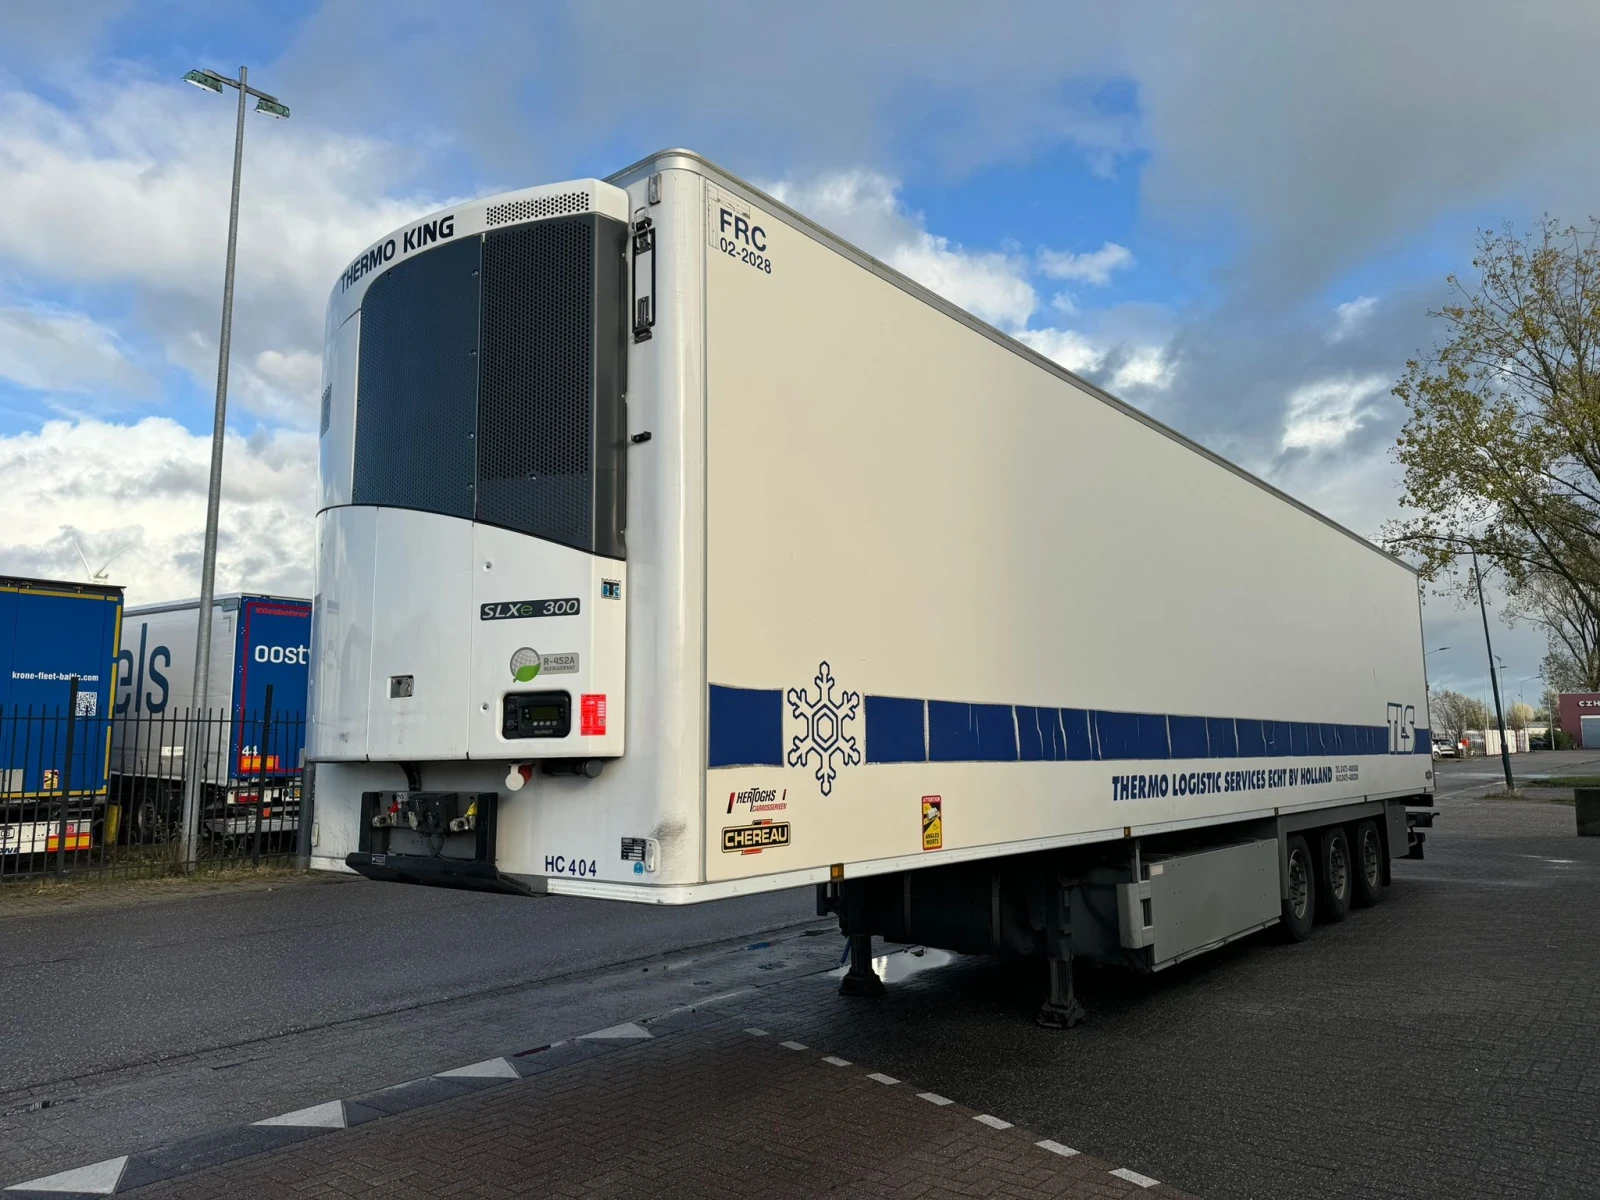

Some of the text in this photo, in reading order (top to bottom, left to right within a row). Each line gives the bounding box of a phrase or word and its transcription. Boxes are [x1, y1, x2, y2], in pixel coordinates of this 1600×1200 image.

[720, 207, 767, 252] FRC
[341, 215, 454, 294] THERMO KING
[720, 237, 772, 274] 02-2028
[542, 600, 578, 615] 300
[255, 644, 311, 665] oost
[543, 656, 575, 666] R-452A
[1112, 774, 1168, 801] THERMO
[1172, 772, 1221, 797] LOGISTIC
[1224, 769, 1266, 792] SERVICES
[1268, 768, 1287, 788] ECHT
[1288, 767, 1299, 786] BV
[1300, 766, 1333, 786] HOLLAND
[736, 788, 776, 812] HERTOGHS
[725, 827, 788, 847] CHEREAU
